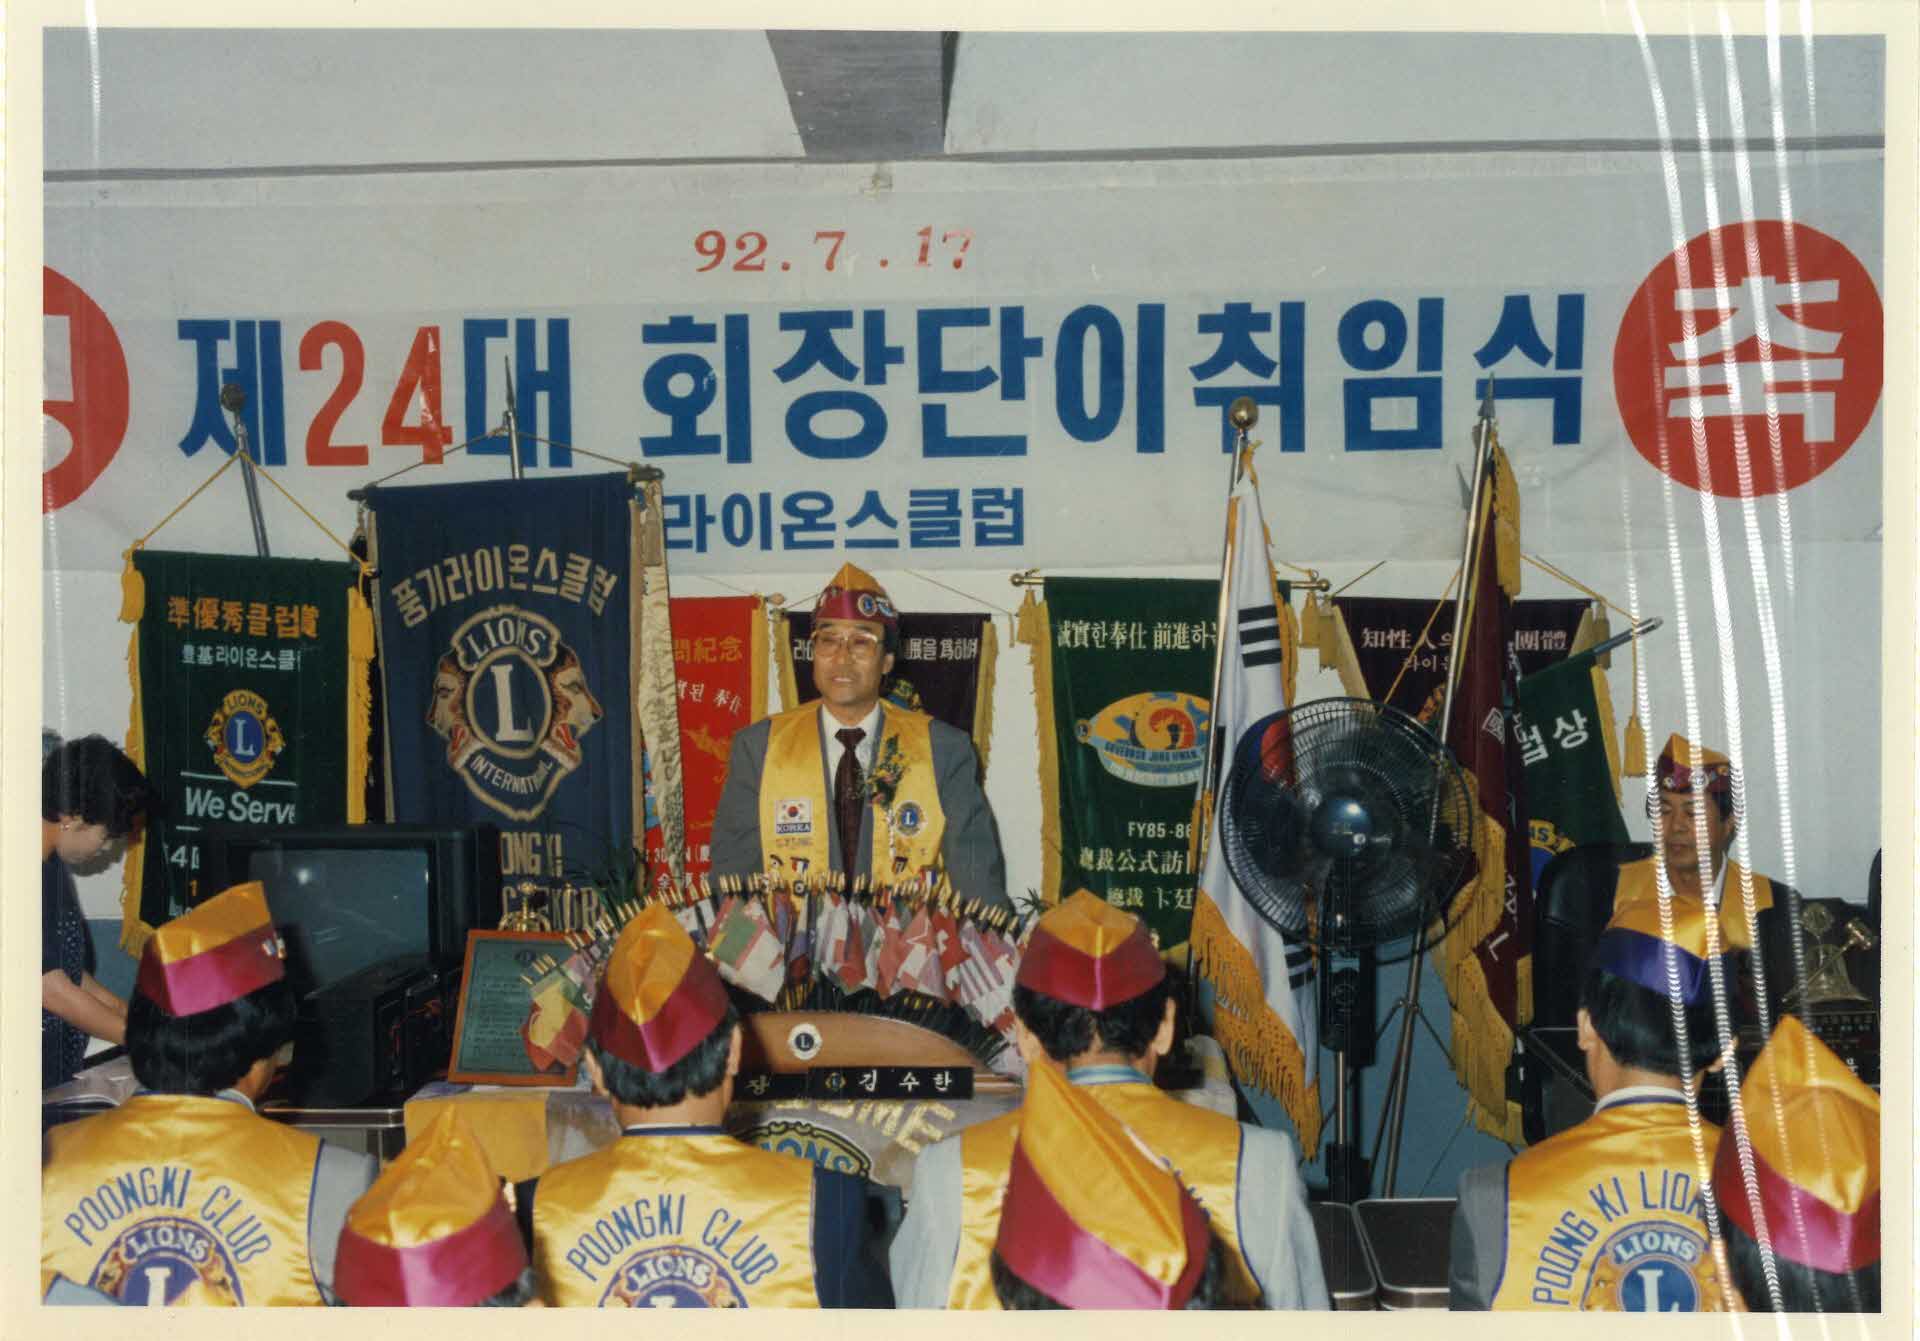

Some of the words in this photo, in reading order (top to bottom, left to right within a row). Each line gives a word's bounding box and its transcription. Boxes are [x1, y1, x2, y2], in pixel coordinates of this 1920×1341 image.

[1663, 276, 1845, 443] 축
[178, 317, 573, 468] 제24대
[466, 617, 547, 660] LIONS
[490, 664, 534, 741] L
[234, 719, 256, 756] L
[185, 787, 225, 820] We
[126, 1226, 210, 1261] LIONS
[199, 1185, 272, 1264] CLUB
[701, 1207, 779, 1286] CLUB
[1614, 1231, 1698, 1264] LIONS
[629, 1255, 711, 1292] LIONS
